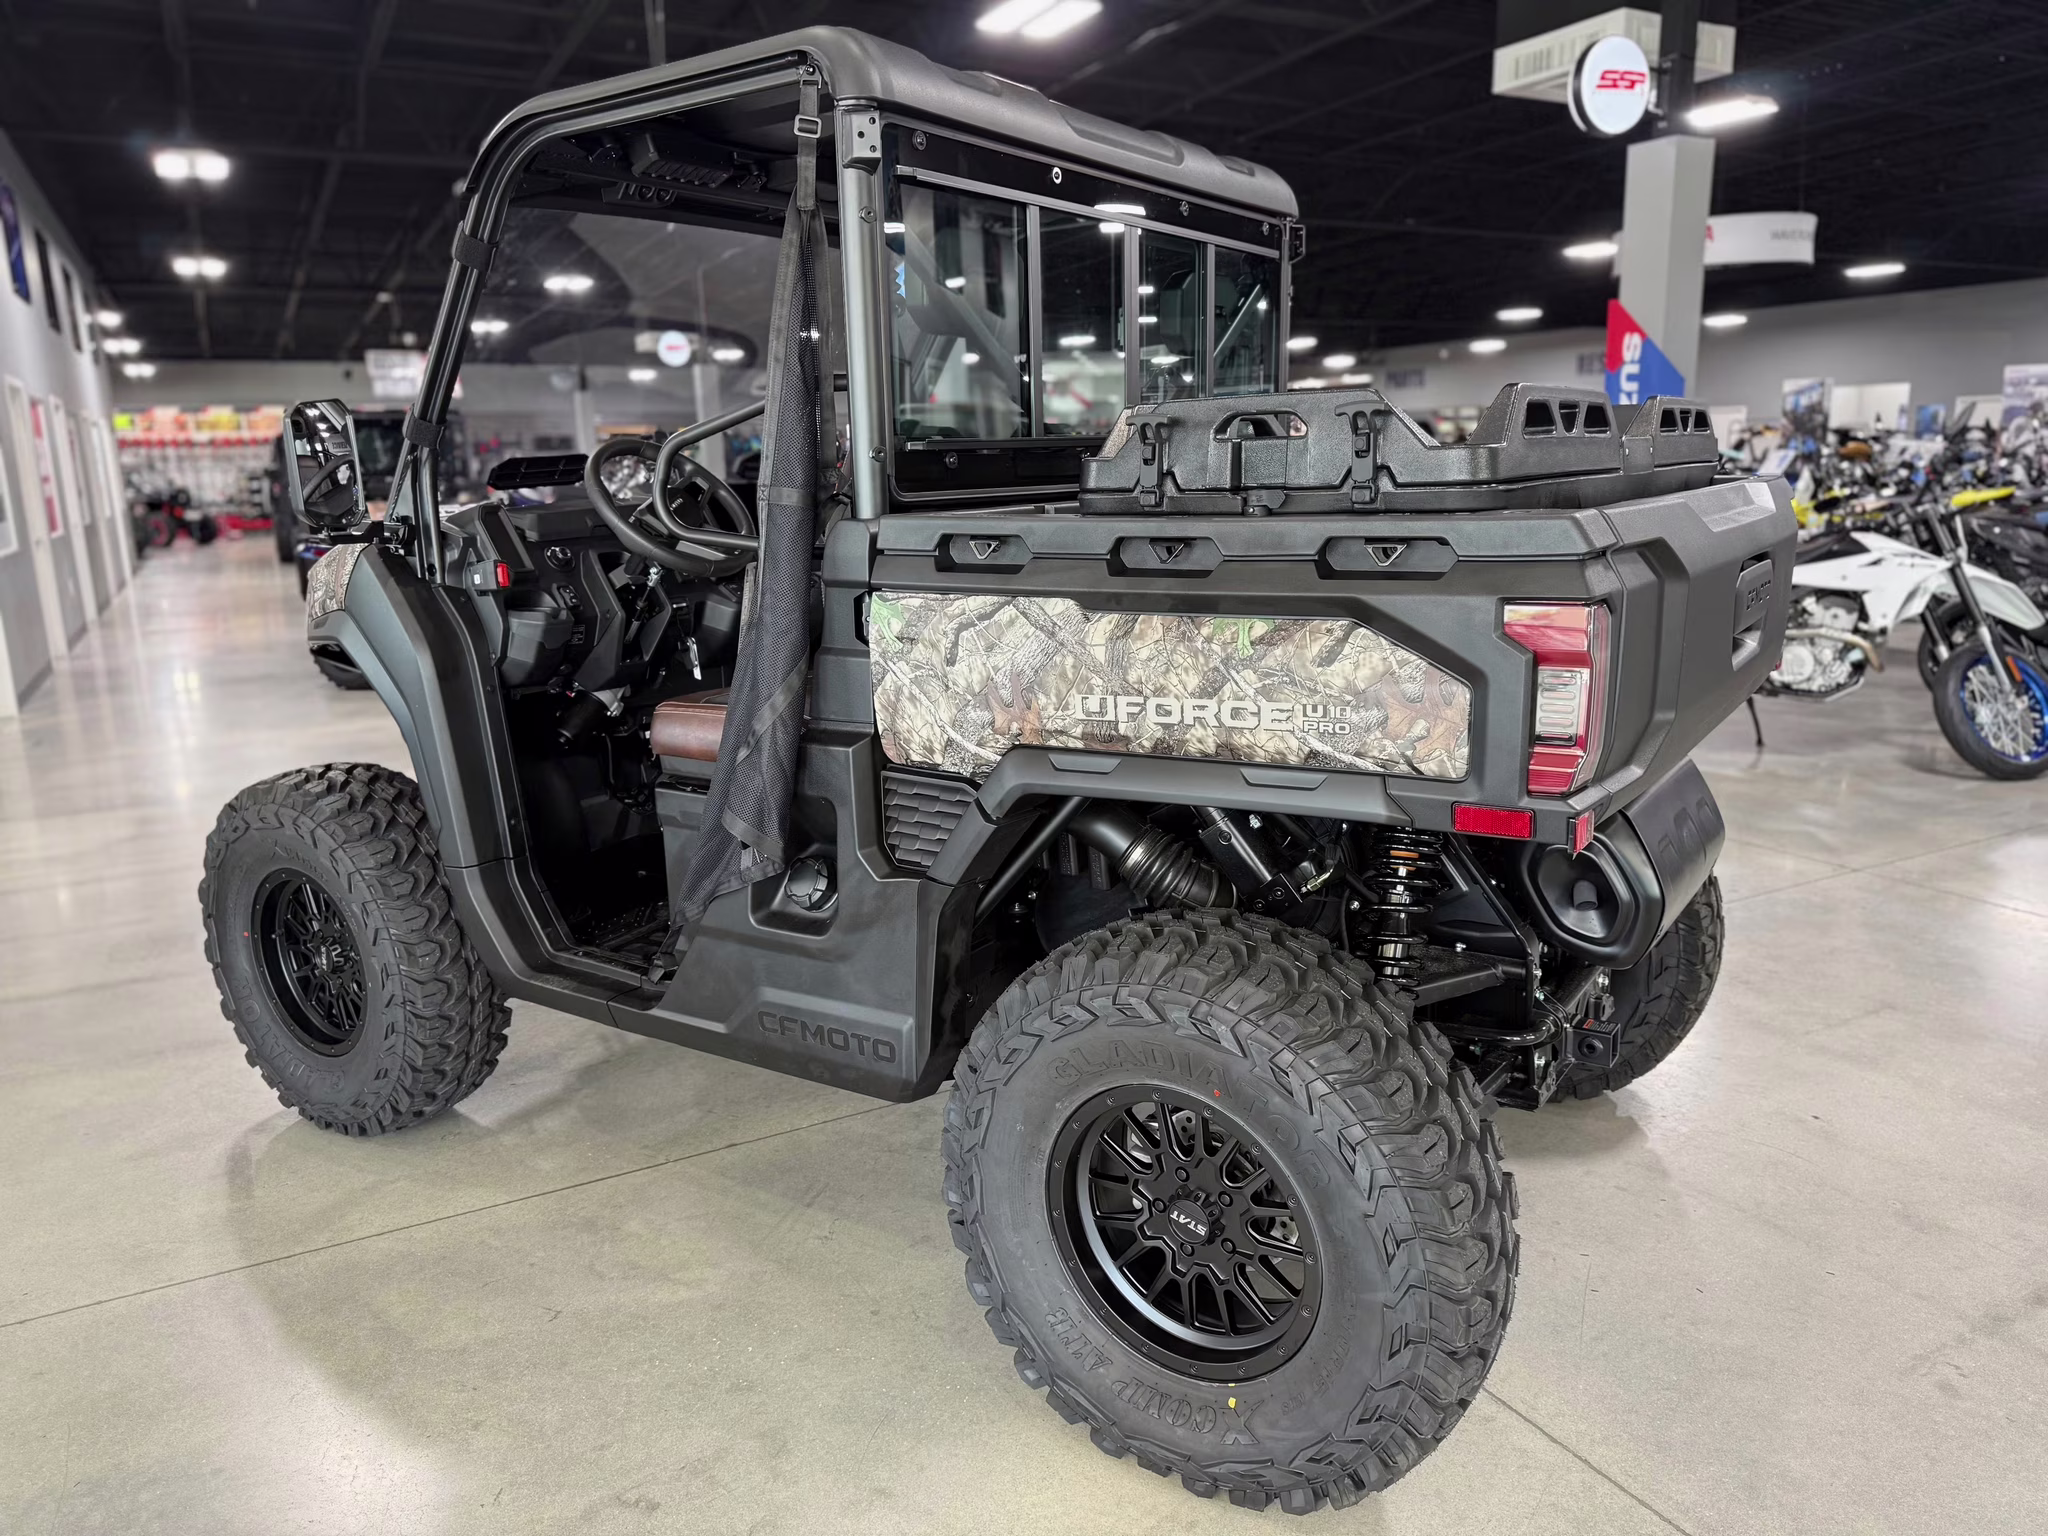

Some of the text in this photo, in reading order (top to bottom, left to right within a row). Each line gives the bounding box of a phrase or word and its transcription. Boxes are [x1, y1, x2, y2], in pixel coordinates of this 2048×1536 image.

[1302, 720, 1351, 735] PRO
[757, 1010, 897, 1064] CFMOTO
[1047, 1040, 1331, 1190] GLADIATOR
[1169, 1210, 1207, 1236] STAT
